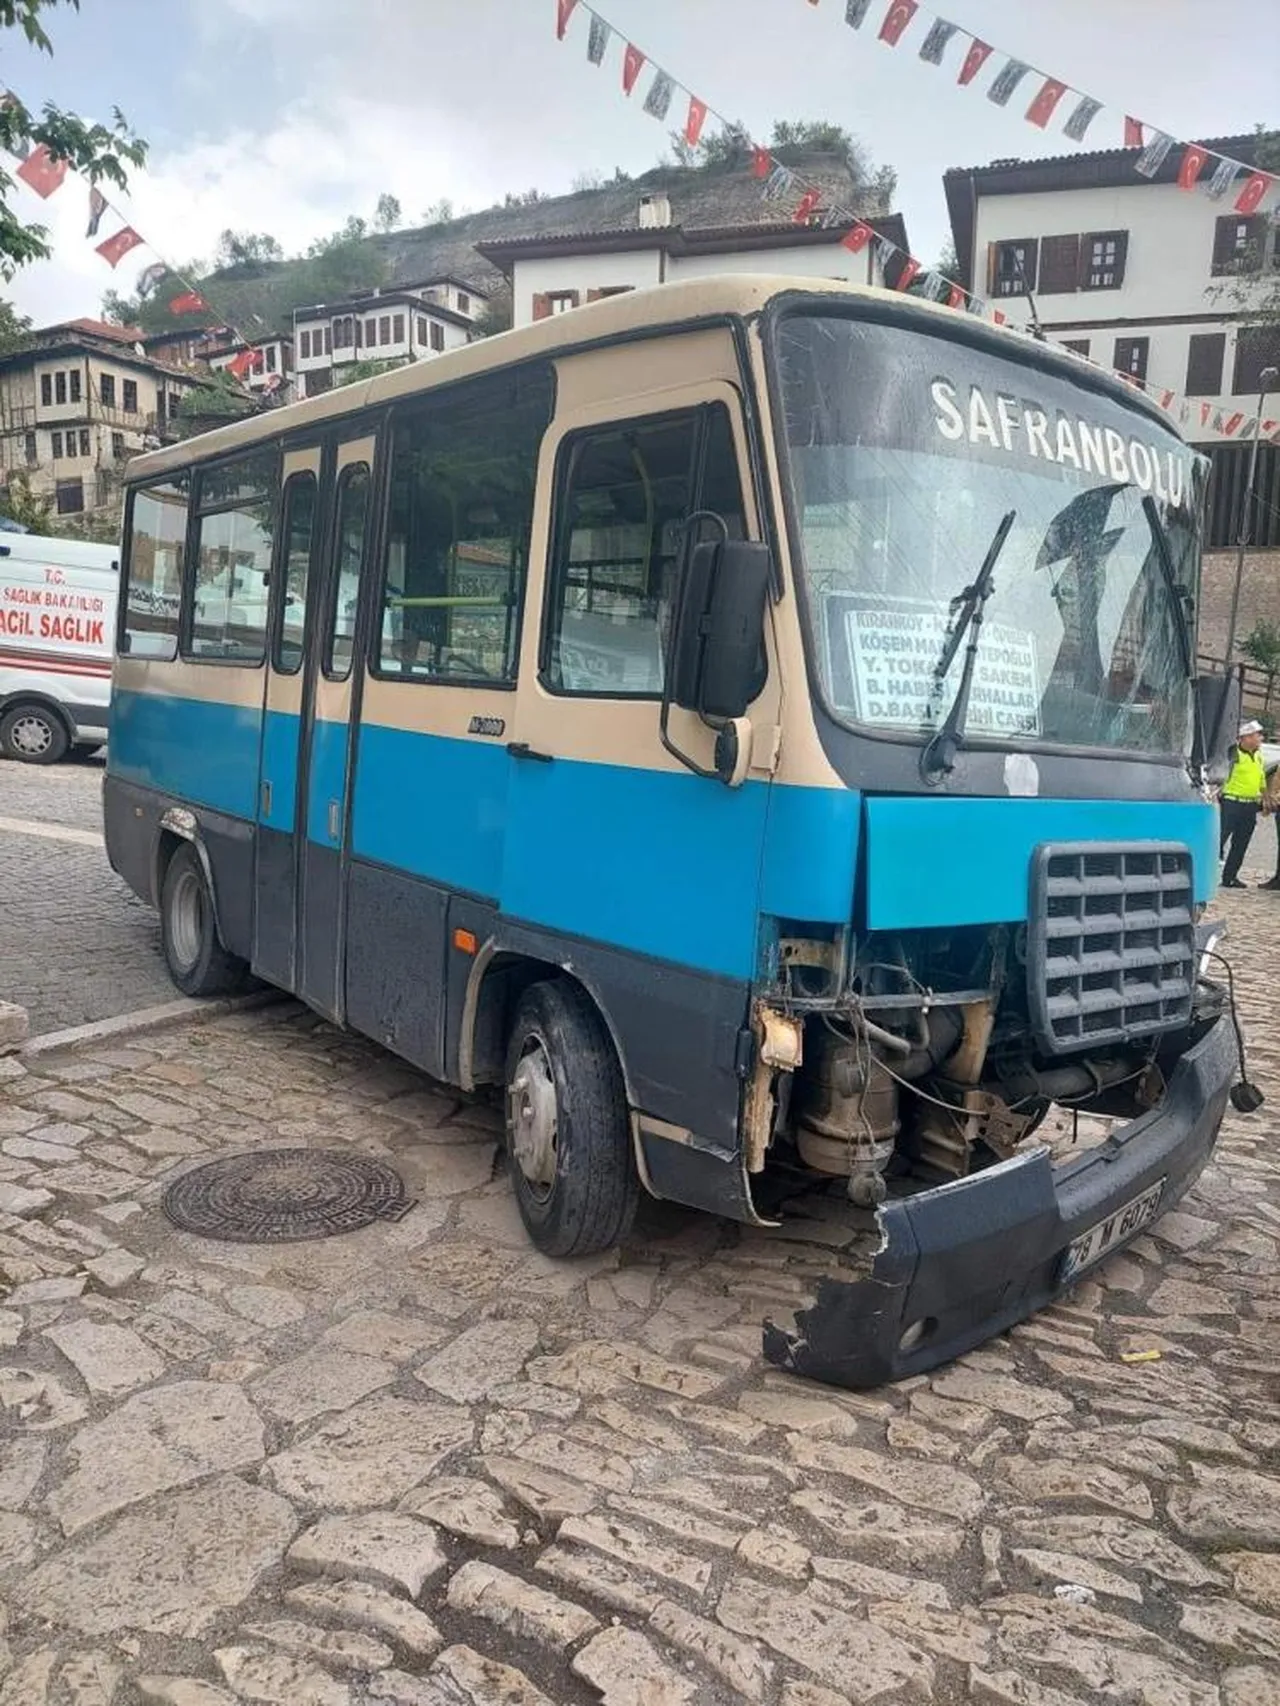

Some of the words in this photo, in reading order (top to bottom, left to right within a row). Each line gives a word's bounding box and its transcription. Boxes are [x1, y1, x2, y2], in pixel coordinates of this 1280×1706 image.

[931, 381, 1183, 508] SAFRANBOLU
[44, 568, 65, 584] T.C.
[40, 612, 104, 644] SAĞLIK
[862, 656, 881, 673] Y.
[867, 678, 885, 695] B.
[1098, 1216, 1117, 1250] M
